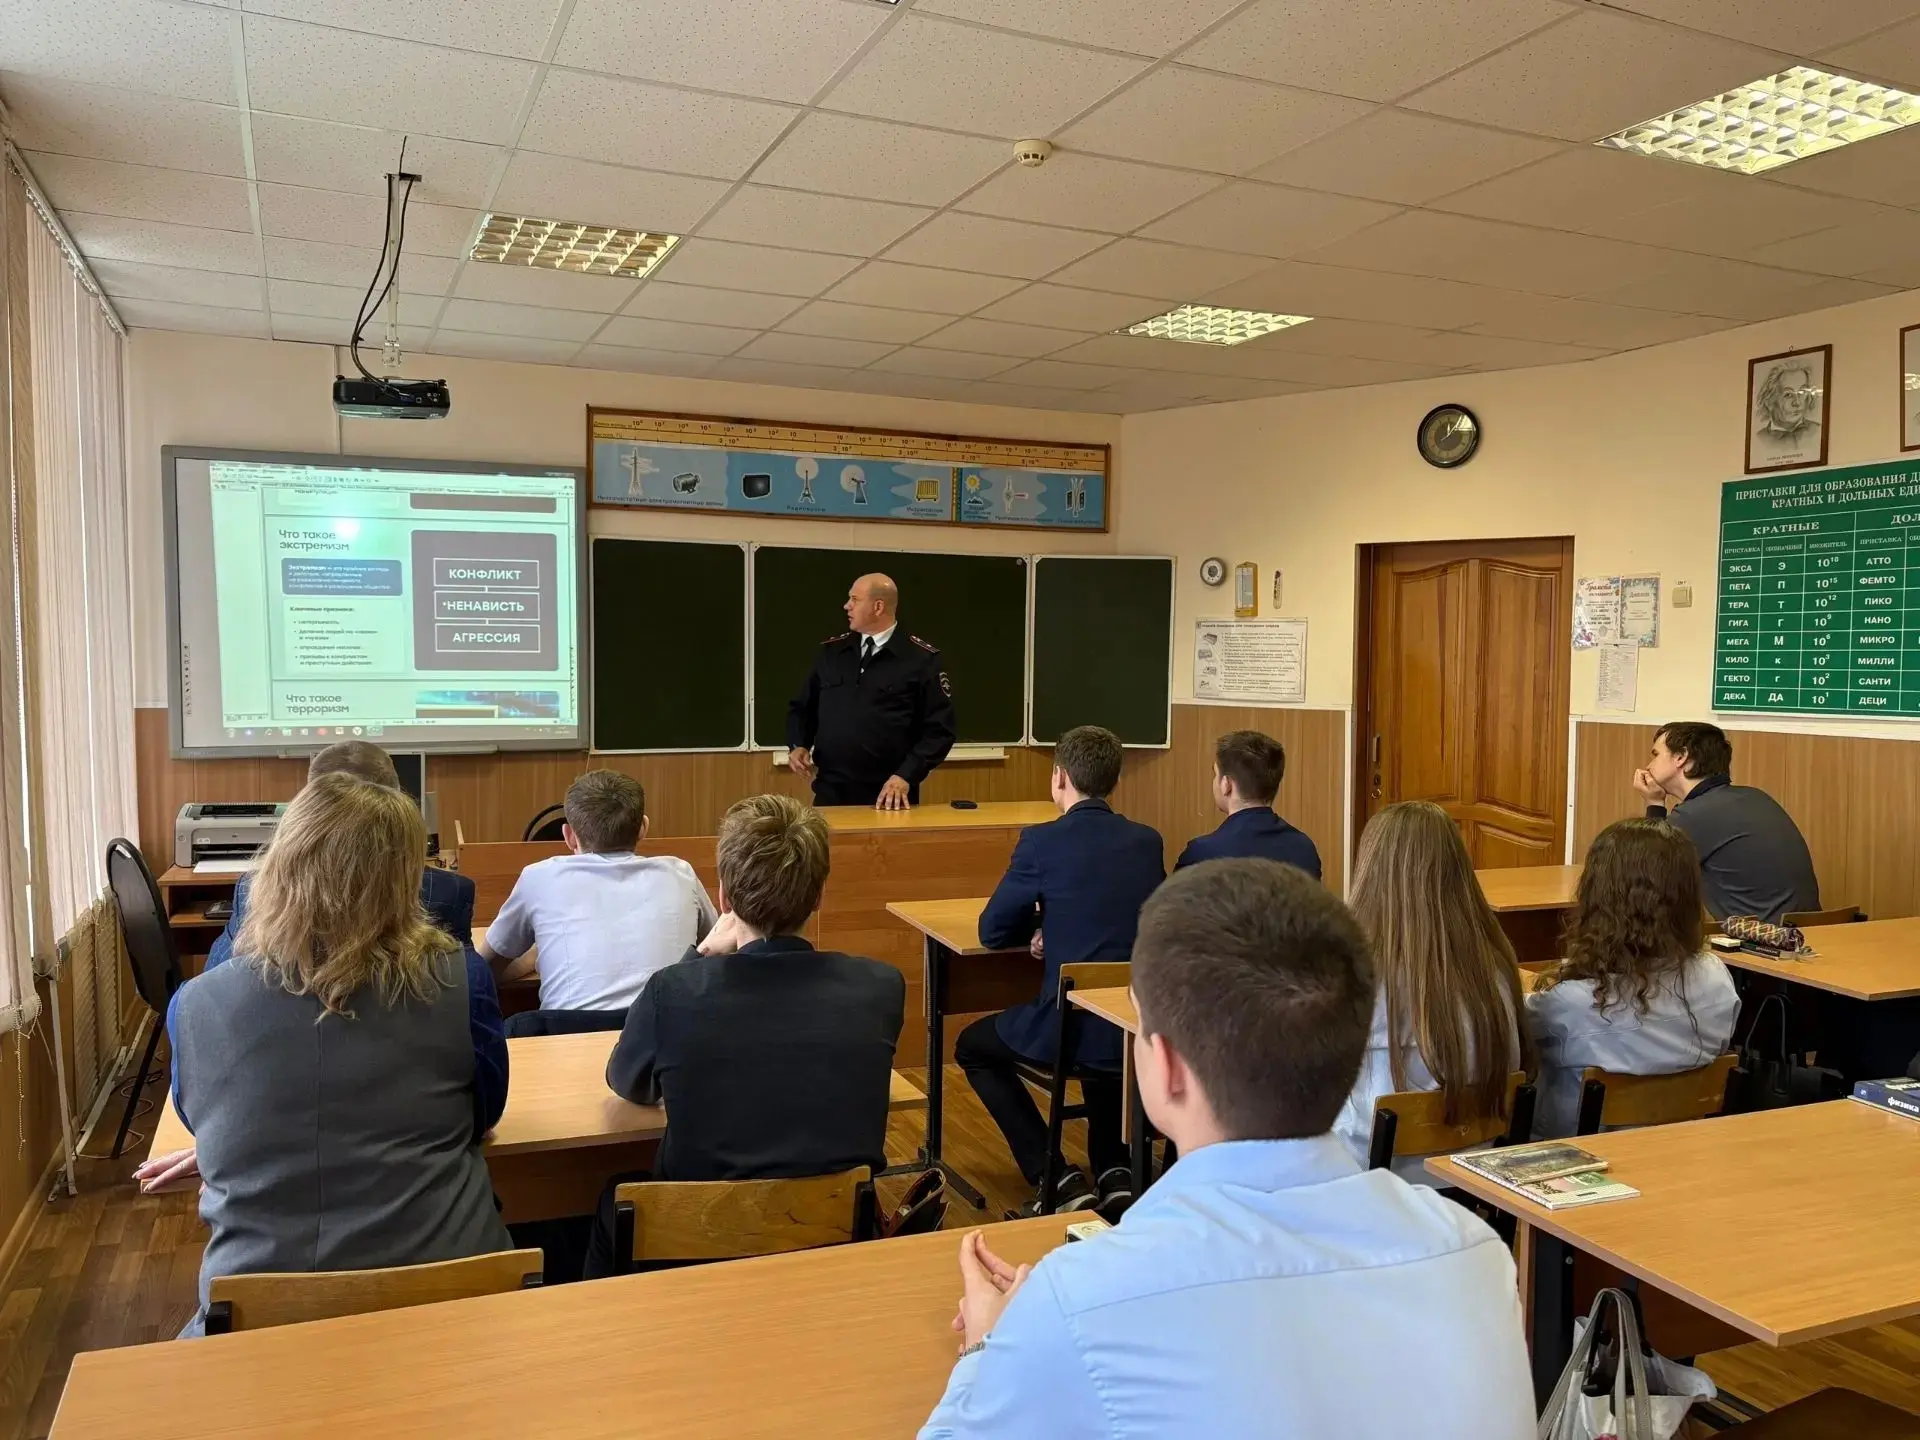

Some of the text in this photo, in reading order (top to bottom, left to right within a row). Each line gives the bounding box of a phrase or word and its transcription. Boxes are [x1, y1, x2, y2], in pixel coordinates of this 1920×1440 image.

[1736, 486, 1796, 500] ПРИСТАВКИ
[1799, 483, 1822, 496] ДЛЯ
[1825, 474, 1906, 491] ОБРАЗОВАНИЯ
[1772, 495, 1824, 508] КРАТНЫХ
[1828, 494, 1835, 503] И
[1838, 488, 1896, 504] ДОЛЬНЫХ
[1753, 522, 1820, 535] КРАТНЫЕ
[279, 530, 336, 540] Что такое
[280, 541, 350, 552] экстремизм
[448, 568, 522, 580] КОНФЛИКТ
[1860, 576, 1896, 585] ФЕМТО
[448, 601, 524, 612] НЕНАВИСТЬ
[1864, 597, 1892, 605] ПИКО
[452, 632, 520, 643] АГРЕССИЯ
[1860, 636, 1895, 644] МИКРО
[1858, 657, 1895, 665] МИЛЛИ
[286, 694, 306, 703] Что
[1859, 697, 1887, 706] ДЕЦИ
[286, 704, 350, 715] терроризм
[1888, 1096, 1920, 1112] физика
